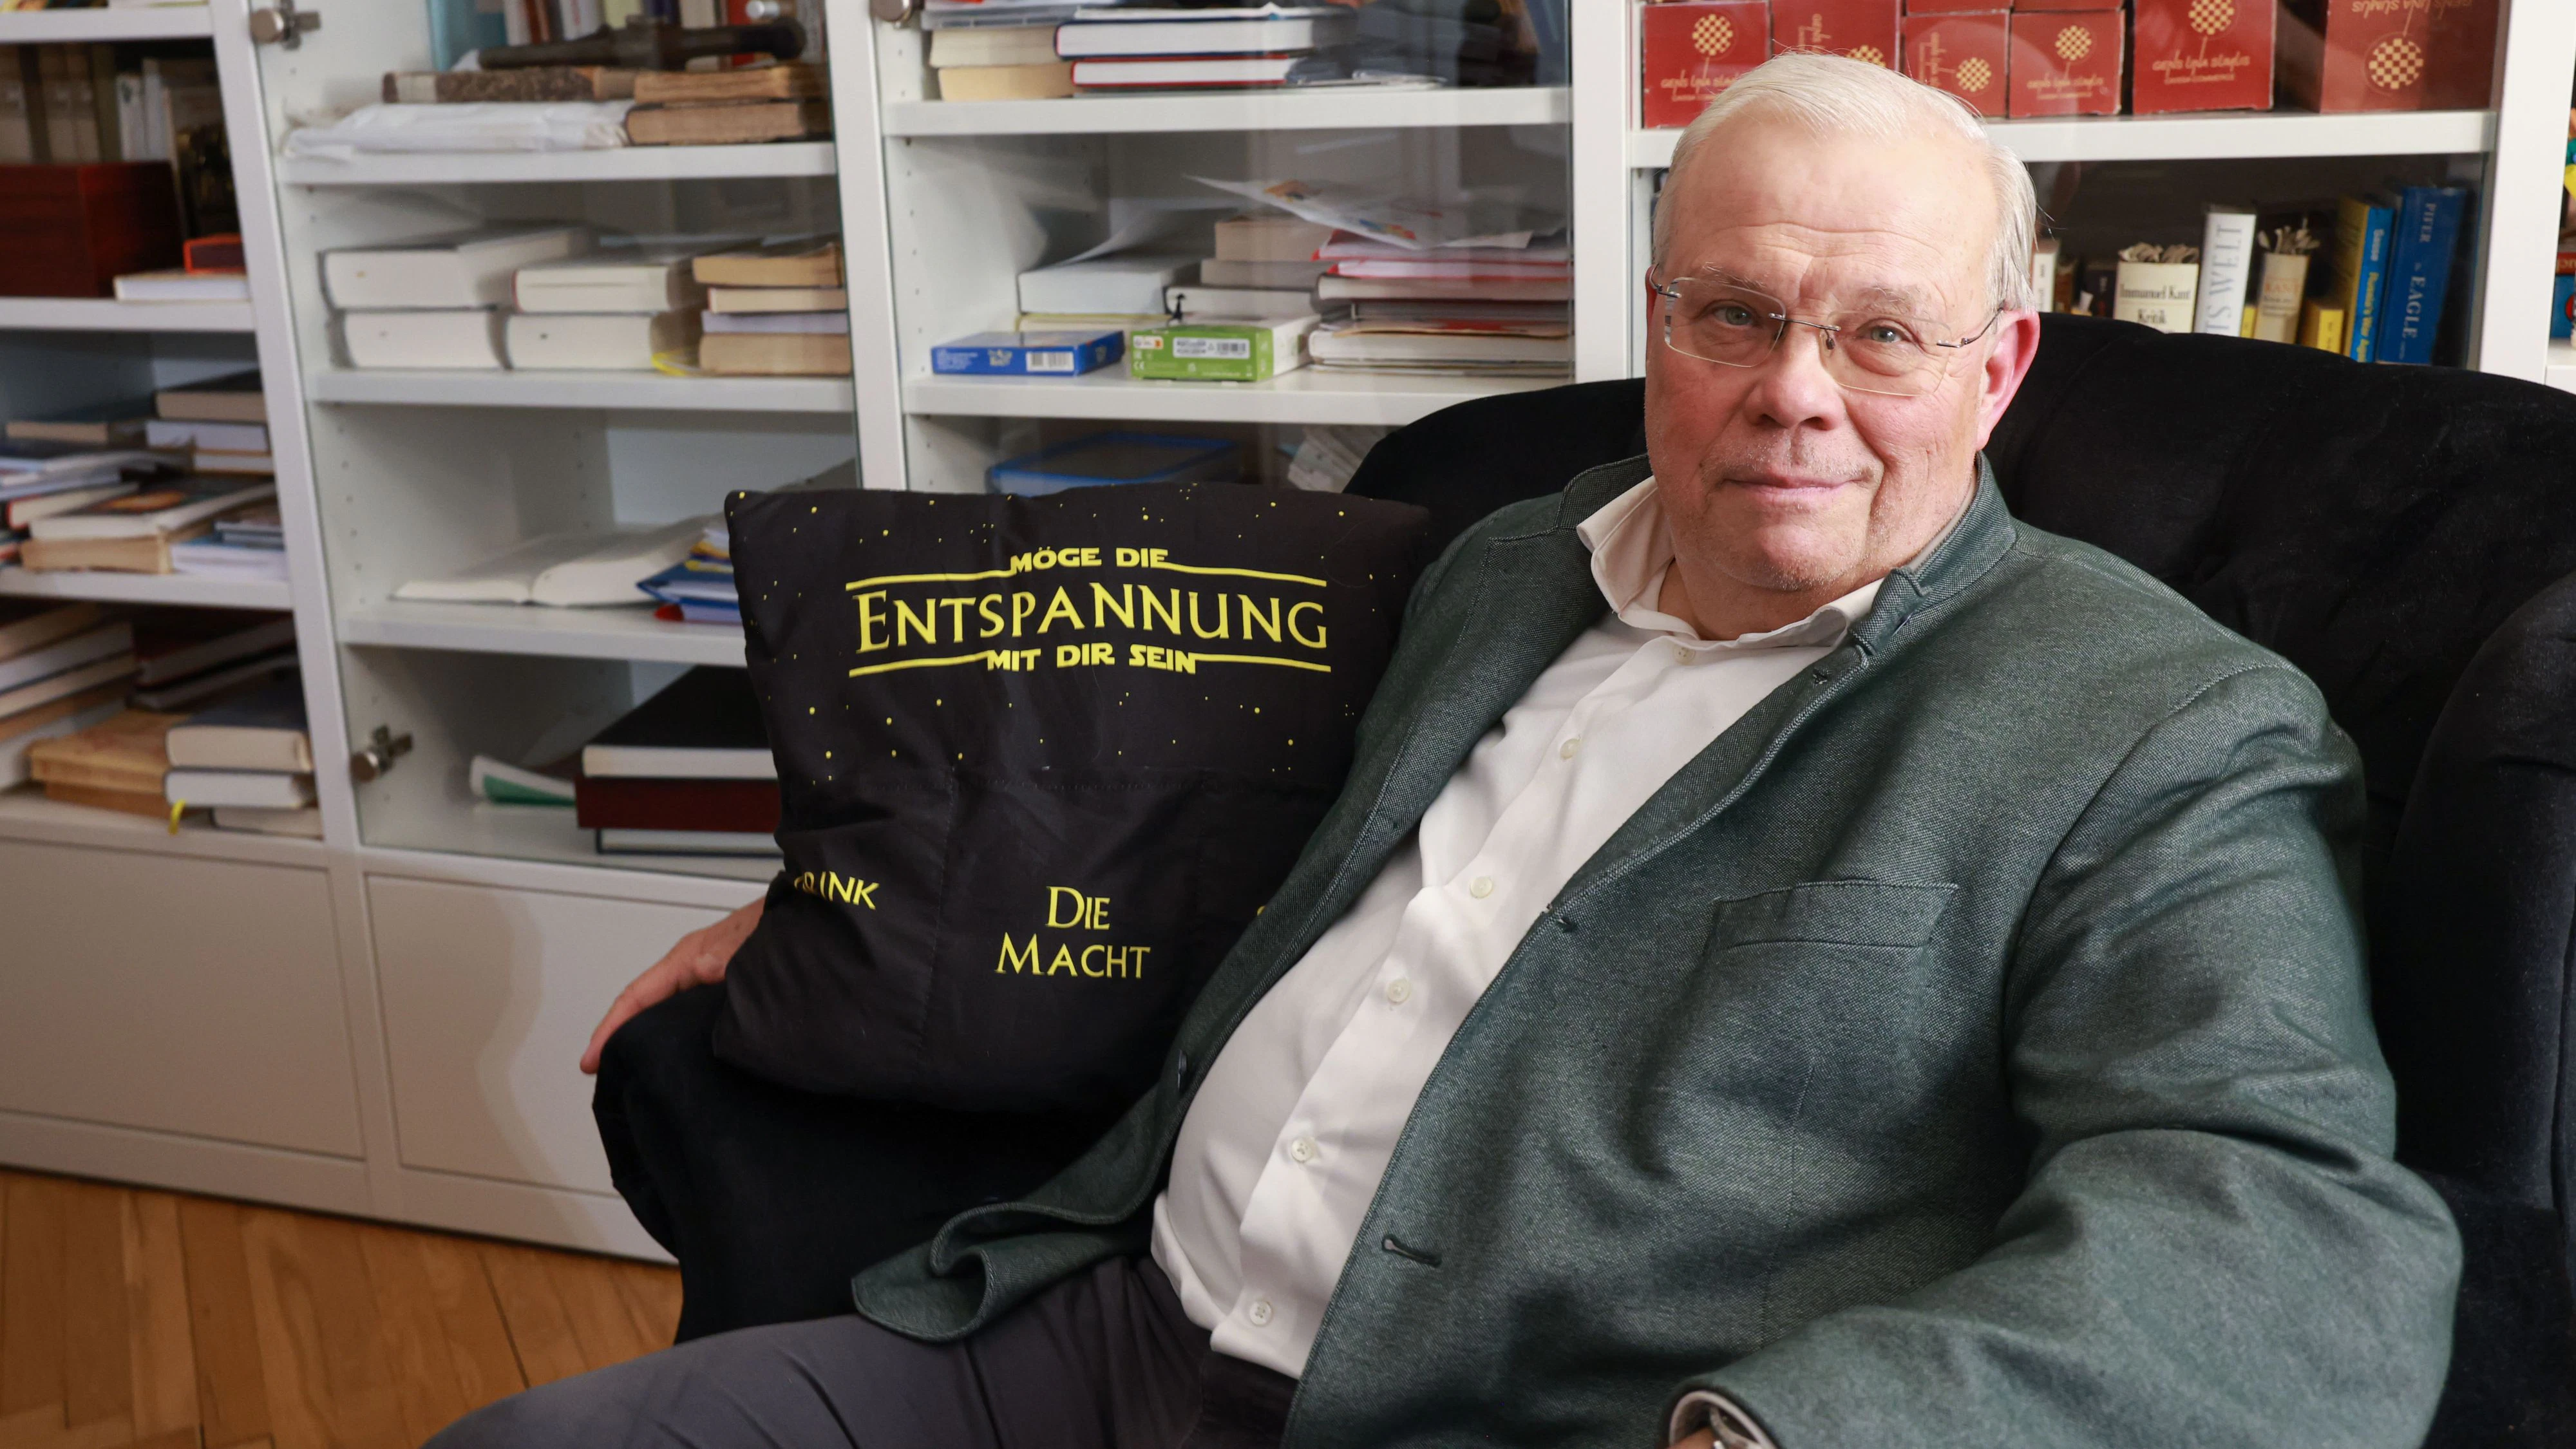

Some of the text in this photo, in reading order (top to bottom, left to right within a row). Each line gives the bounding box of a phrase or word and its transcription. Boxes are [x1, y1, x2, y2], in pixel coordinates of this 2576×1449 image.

[2209, 223, 2242, 296] WELT
[2402, 276, 2427, 338] EAGLE
[1010, 545, 1169, 573] MÖGE DIE
[987, 642, 1196, 675] MIT DIR SEIN
[793, 871, 880, 910] RINK
